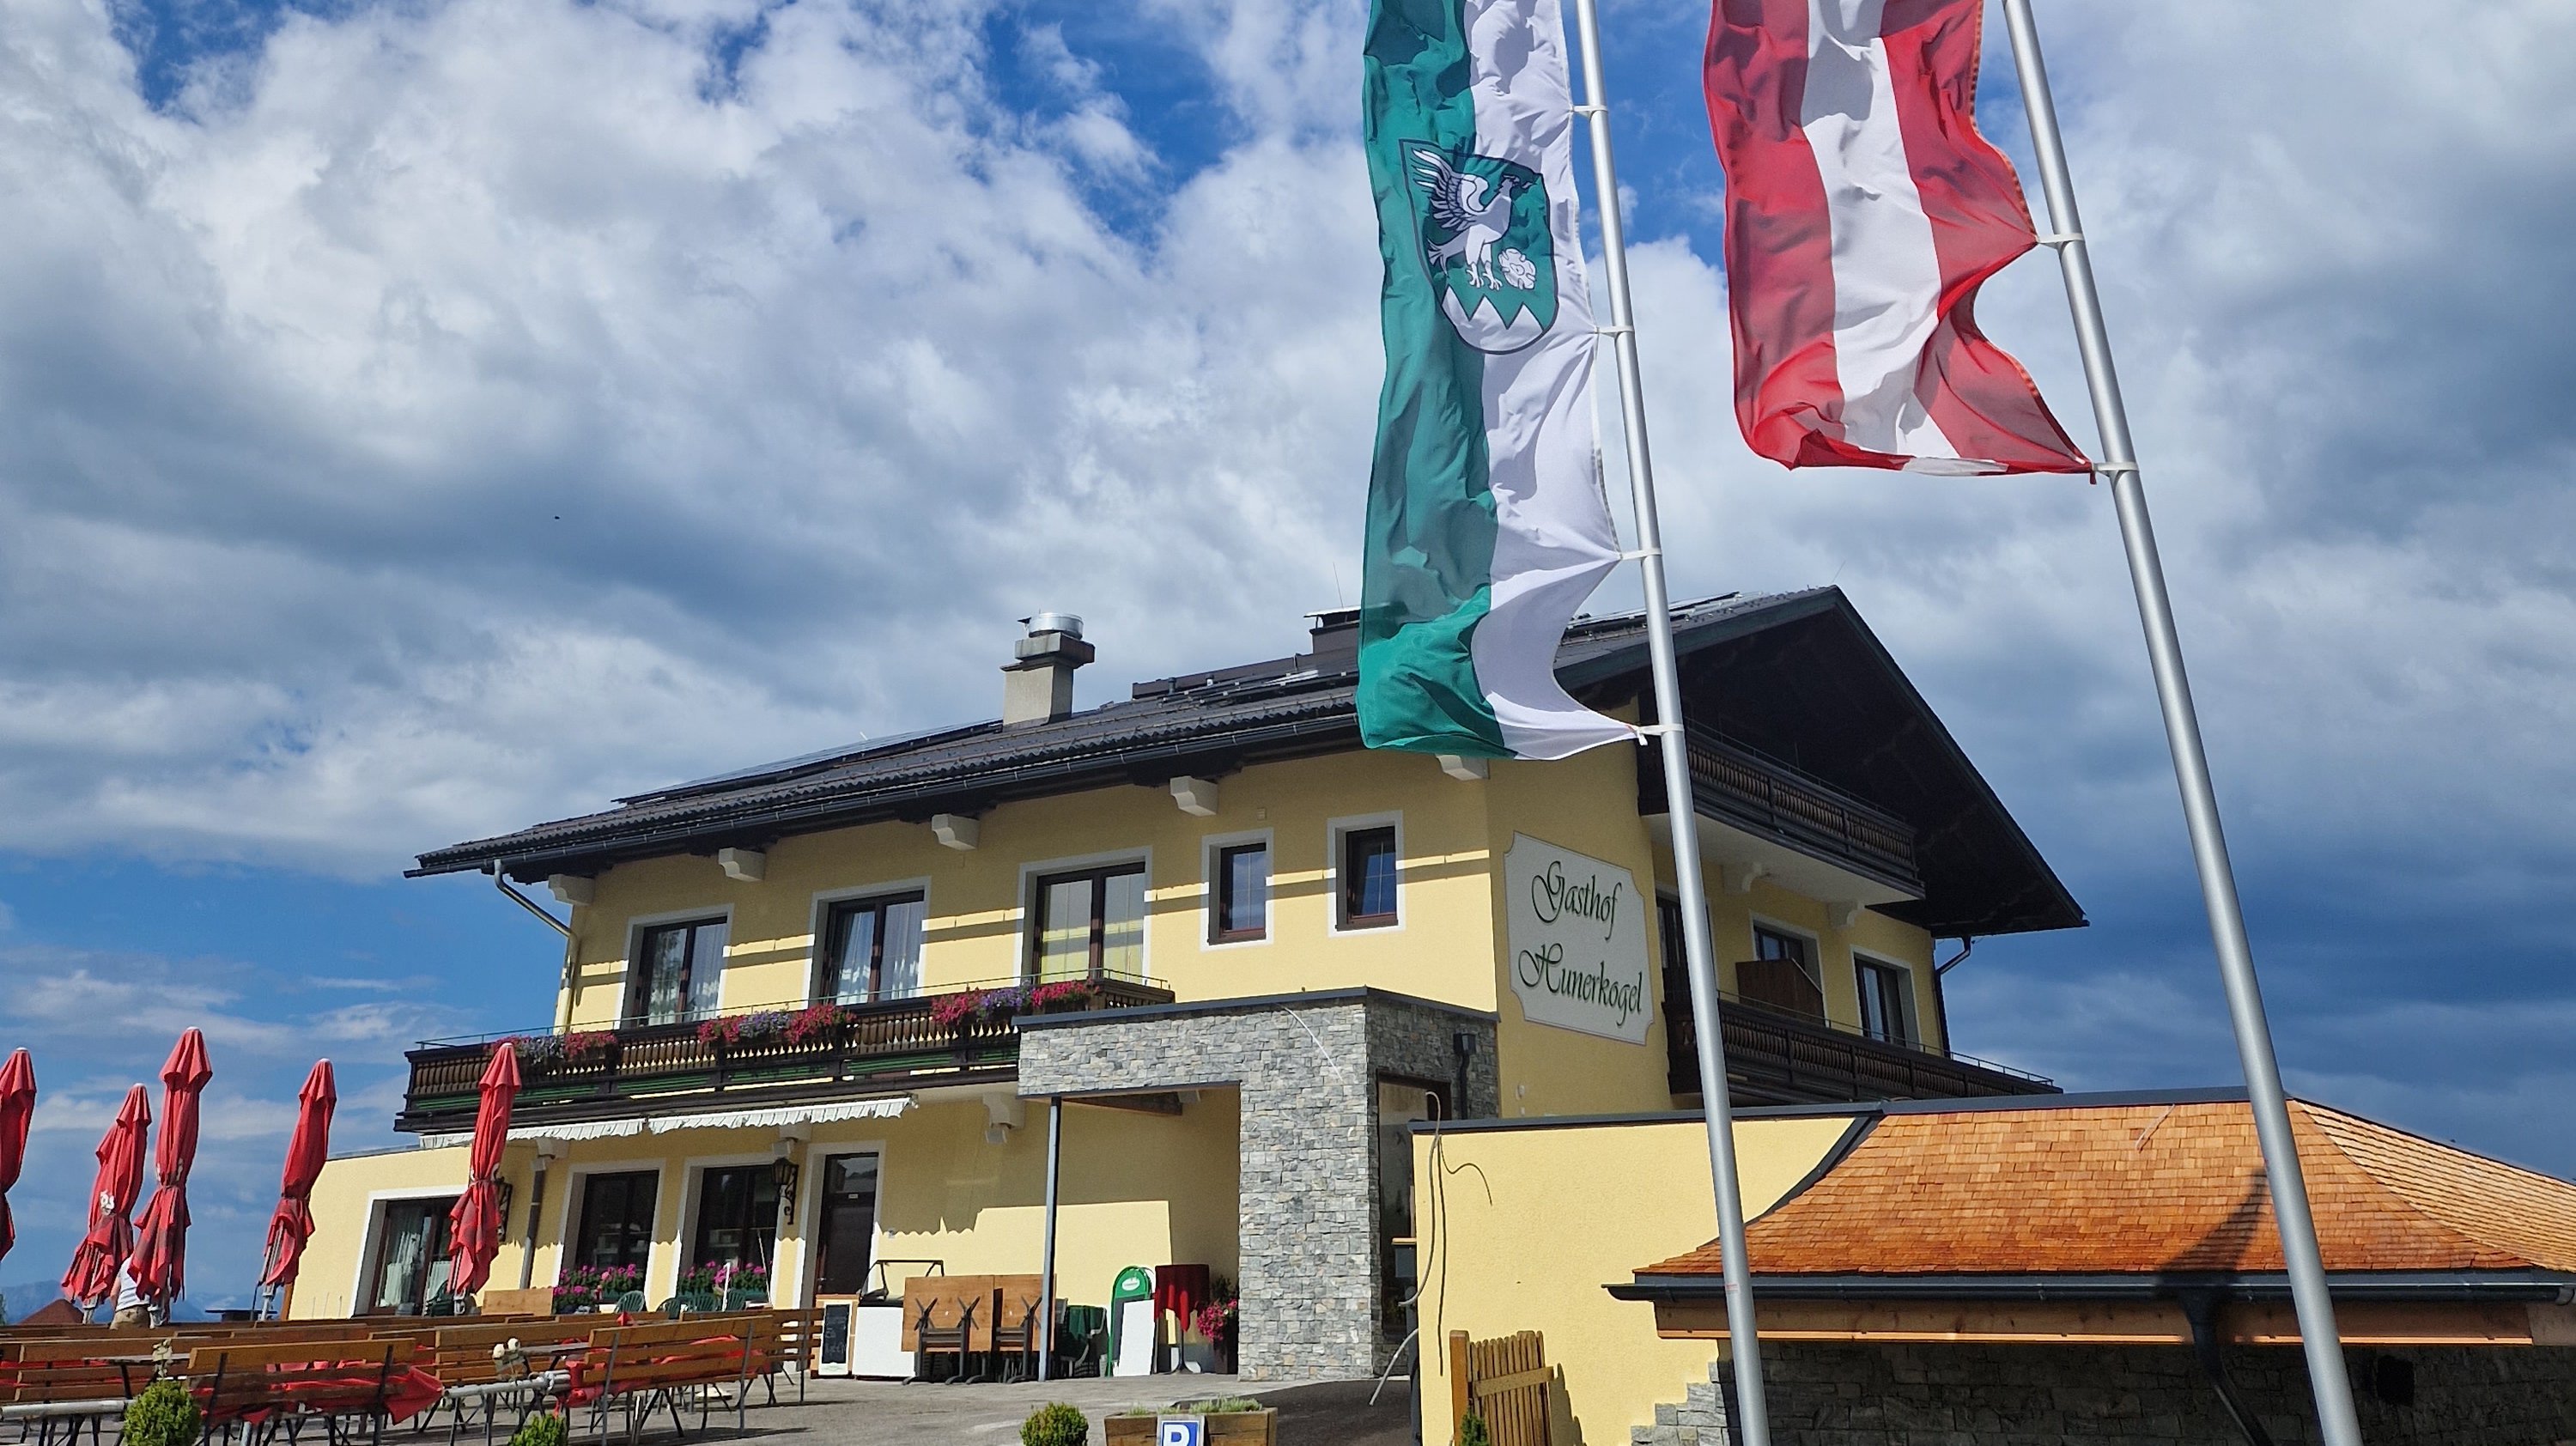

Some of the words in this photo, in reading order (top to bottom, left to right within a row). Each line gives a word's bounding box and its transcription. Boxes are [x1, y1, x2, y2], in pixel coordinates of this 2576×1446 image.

[1531, 860, 1622, 941] Gasthof
[1518, 943, 1643, 1027] Hunerkogel
[1163, 1425, 1190, 1446] P
